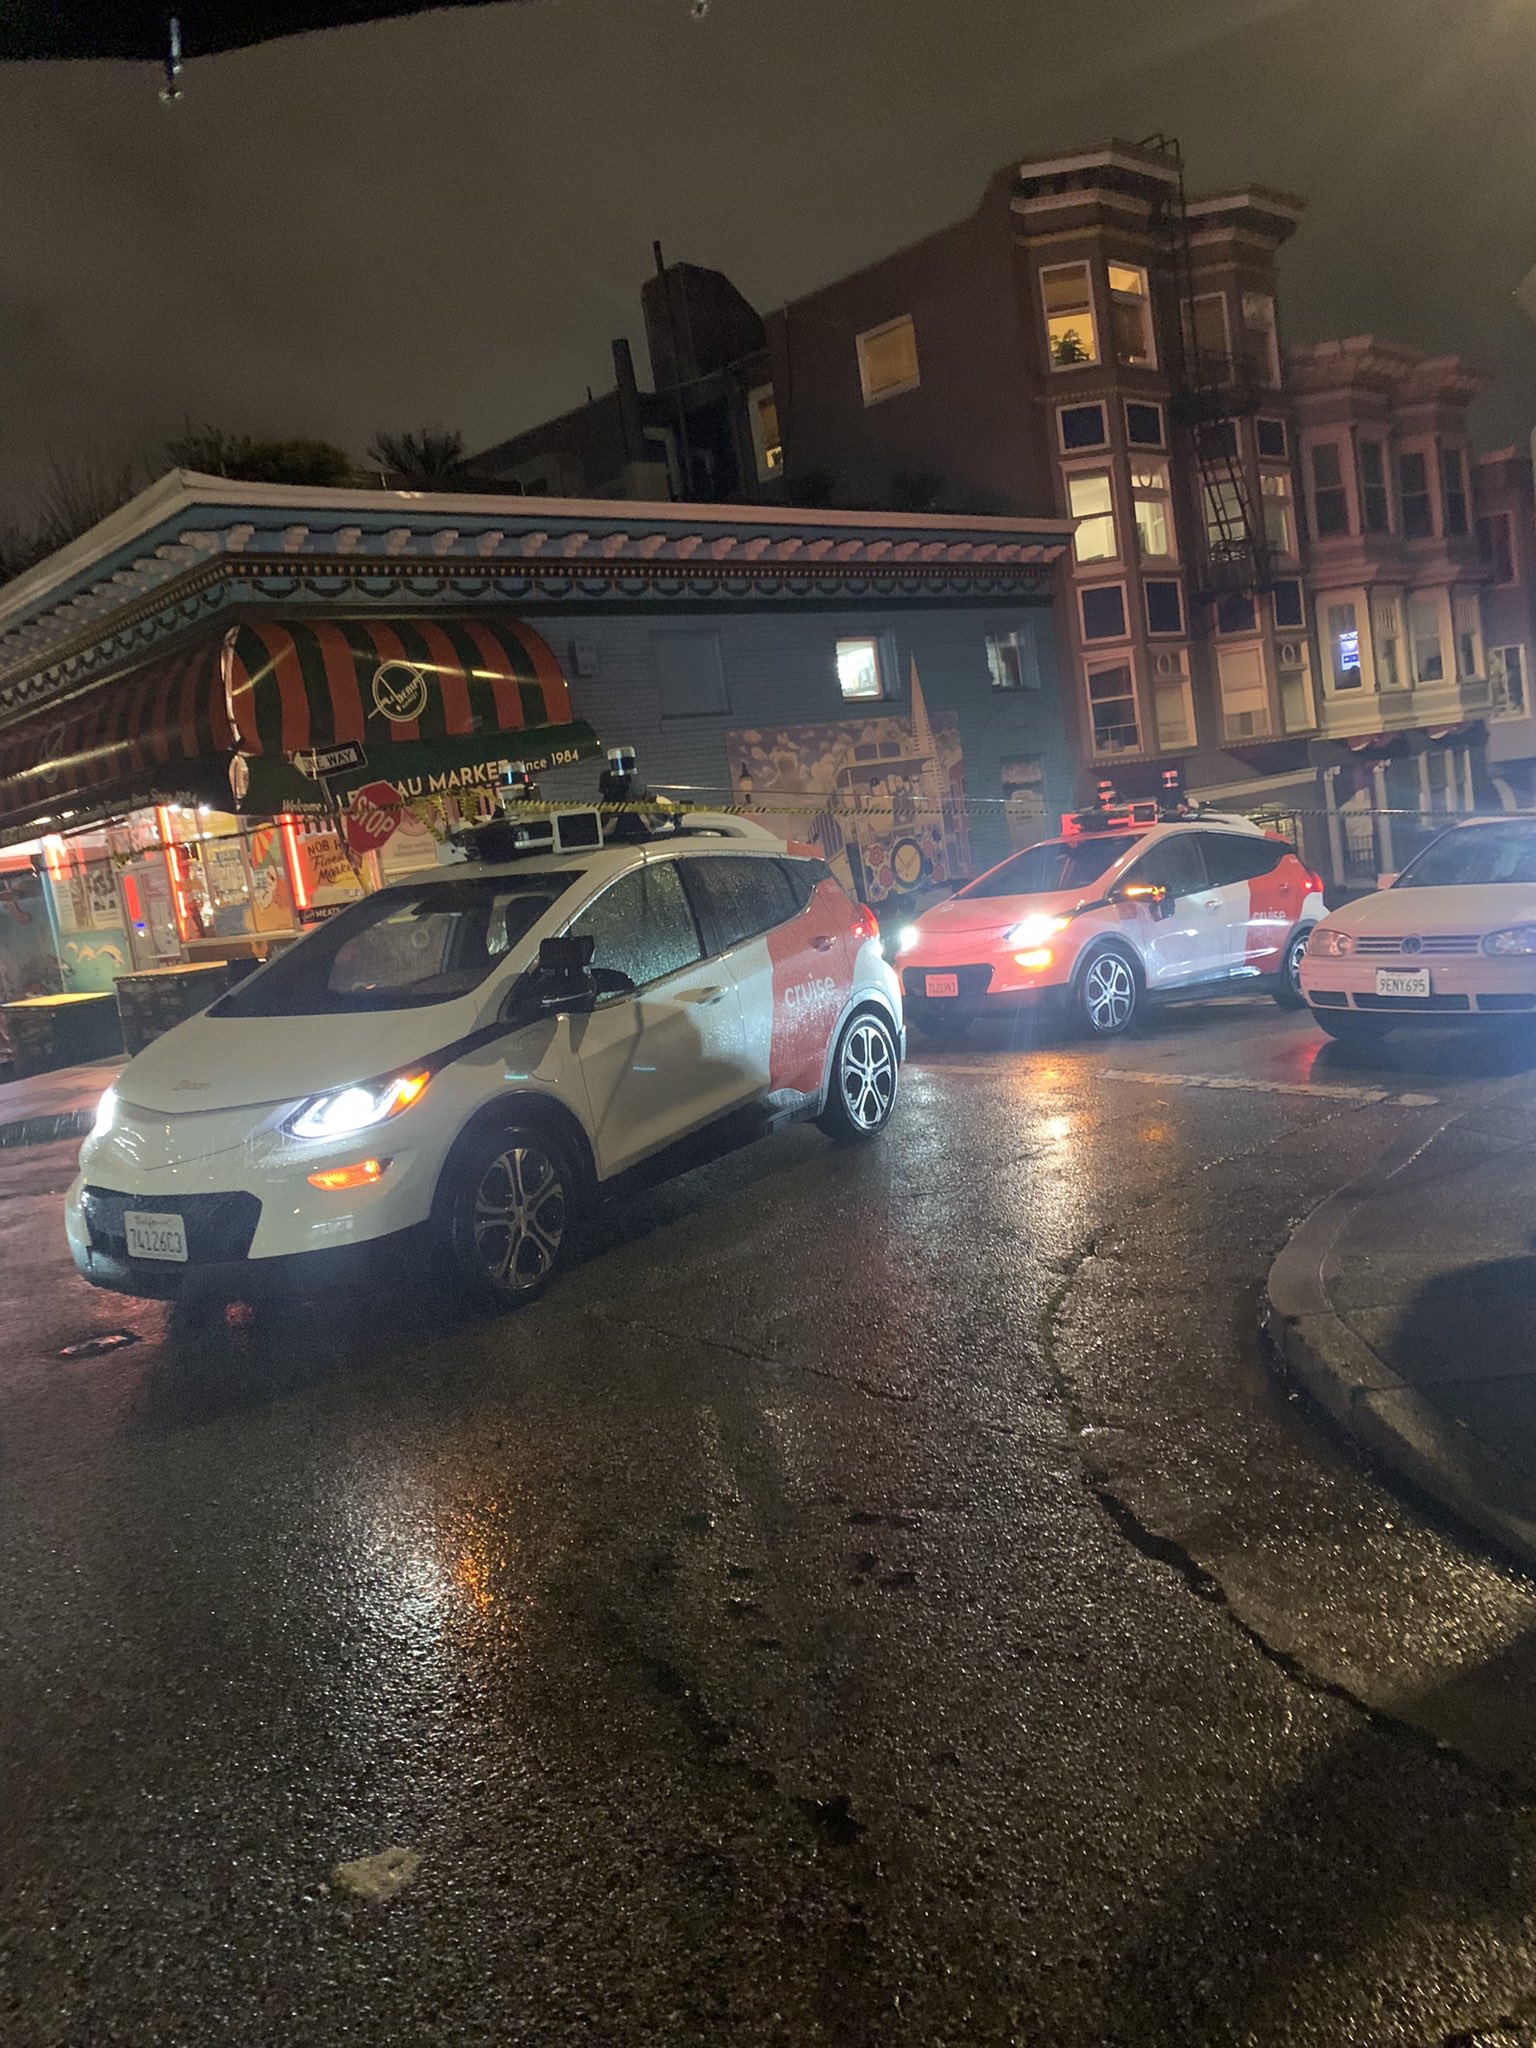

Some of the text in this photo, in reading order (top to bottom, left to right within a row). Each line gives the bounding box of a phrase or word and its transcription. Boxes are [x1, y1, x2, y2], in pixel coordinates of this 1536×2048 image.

[303, 750, 353, 770] ONE WAY
[550, 749, 579, 766] 1984
[351, 796, 395, 838] STOP
[307, 839, 330, 857] NOB
[1252, 906, 1287, 920] cruise
[784, 972, 836, 1009] cruise
[1379, 978, 1426, 993] 9ENY695
